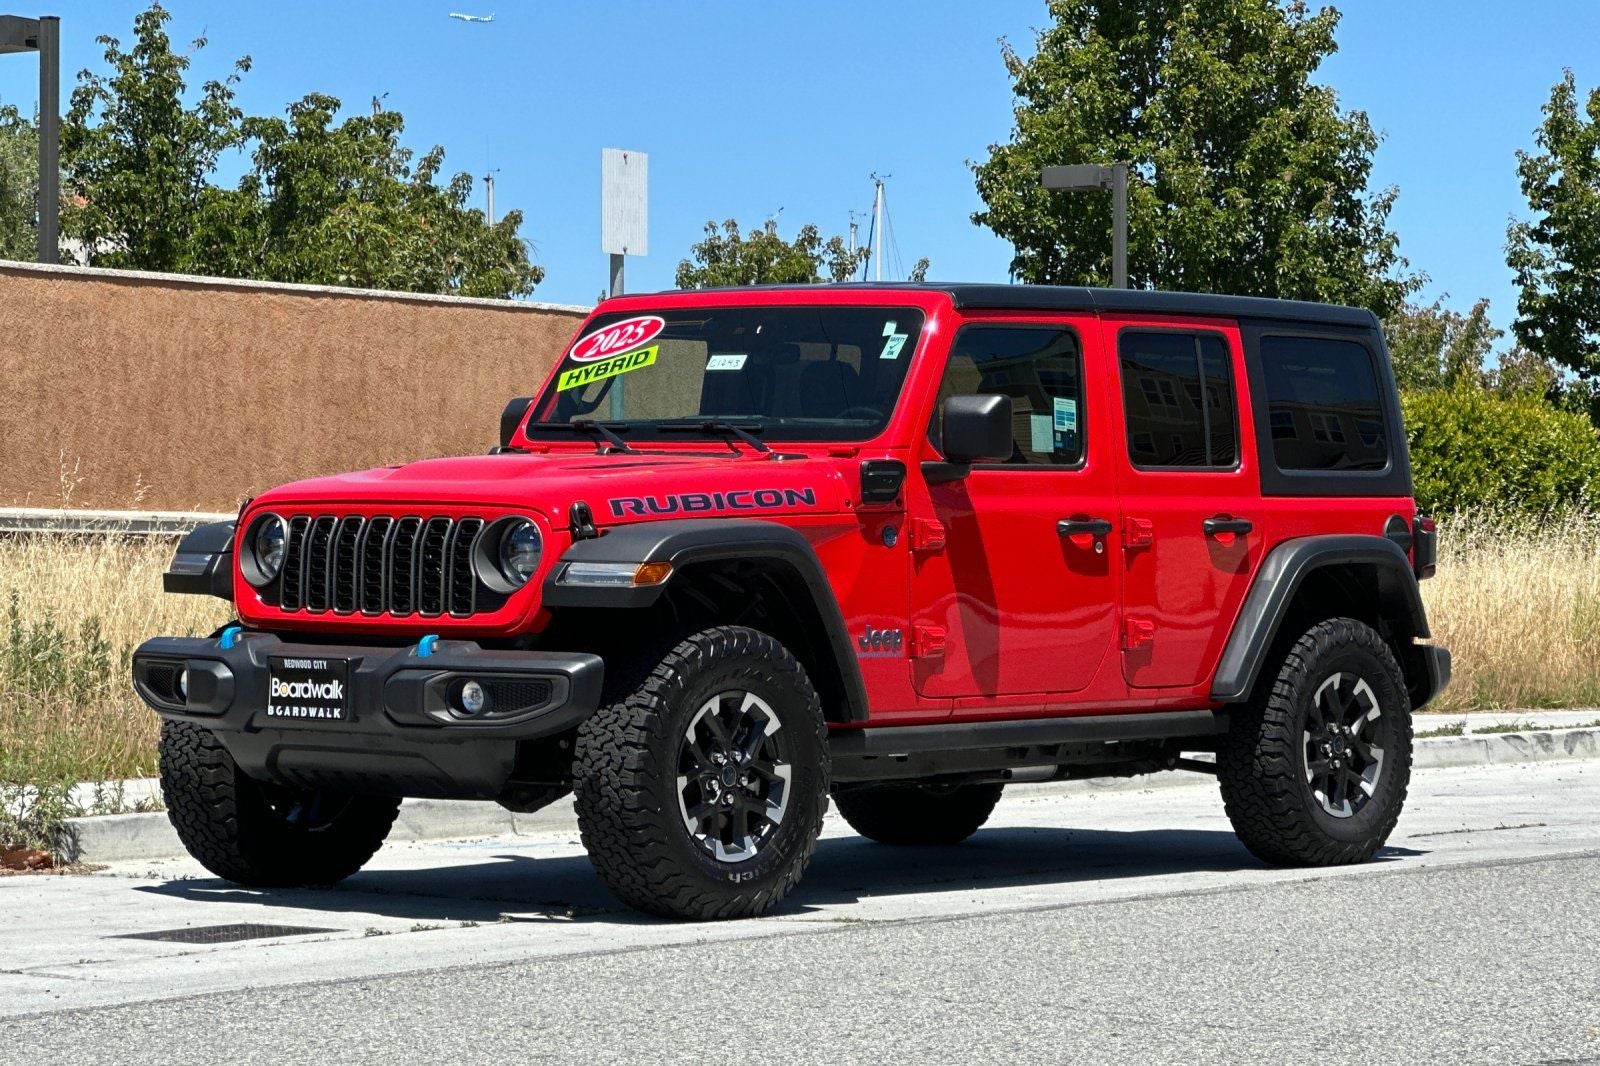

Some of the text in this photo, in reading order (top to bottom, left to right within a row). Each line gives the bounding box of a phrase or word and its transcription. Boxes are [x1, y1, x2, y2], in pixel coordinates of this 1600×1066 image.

[583, 319, 651, 358] 2025
[565, 350, 650, 386] HYBRID
[608, 487, 816, 518] RUBICON
[858, 624, 903, 653] Jeep
[284, 659, 327, 670] REDWOOD CITY
[271, 677, 343, 700] Boardwalk
[267, 704, 341, 719] BOARDWALK
